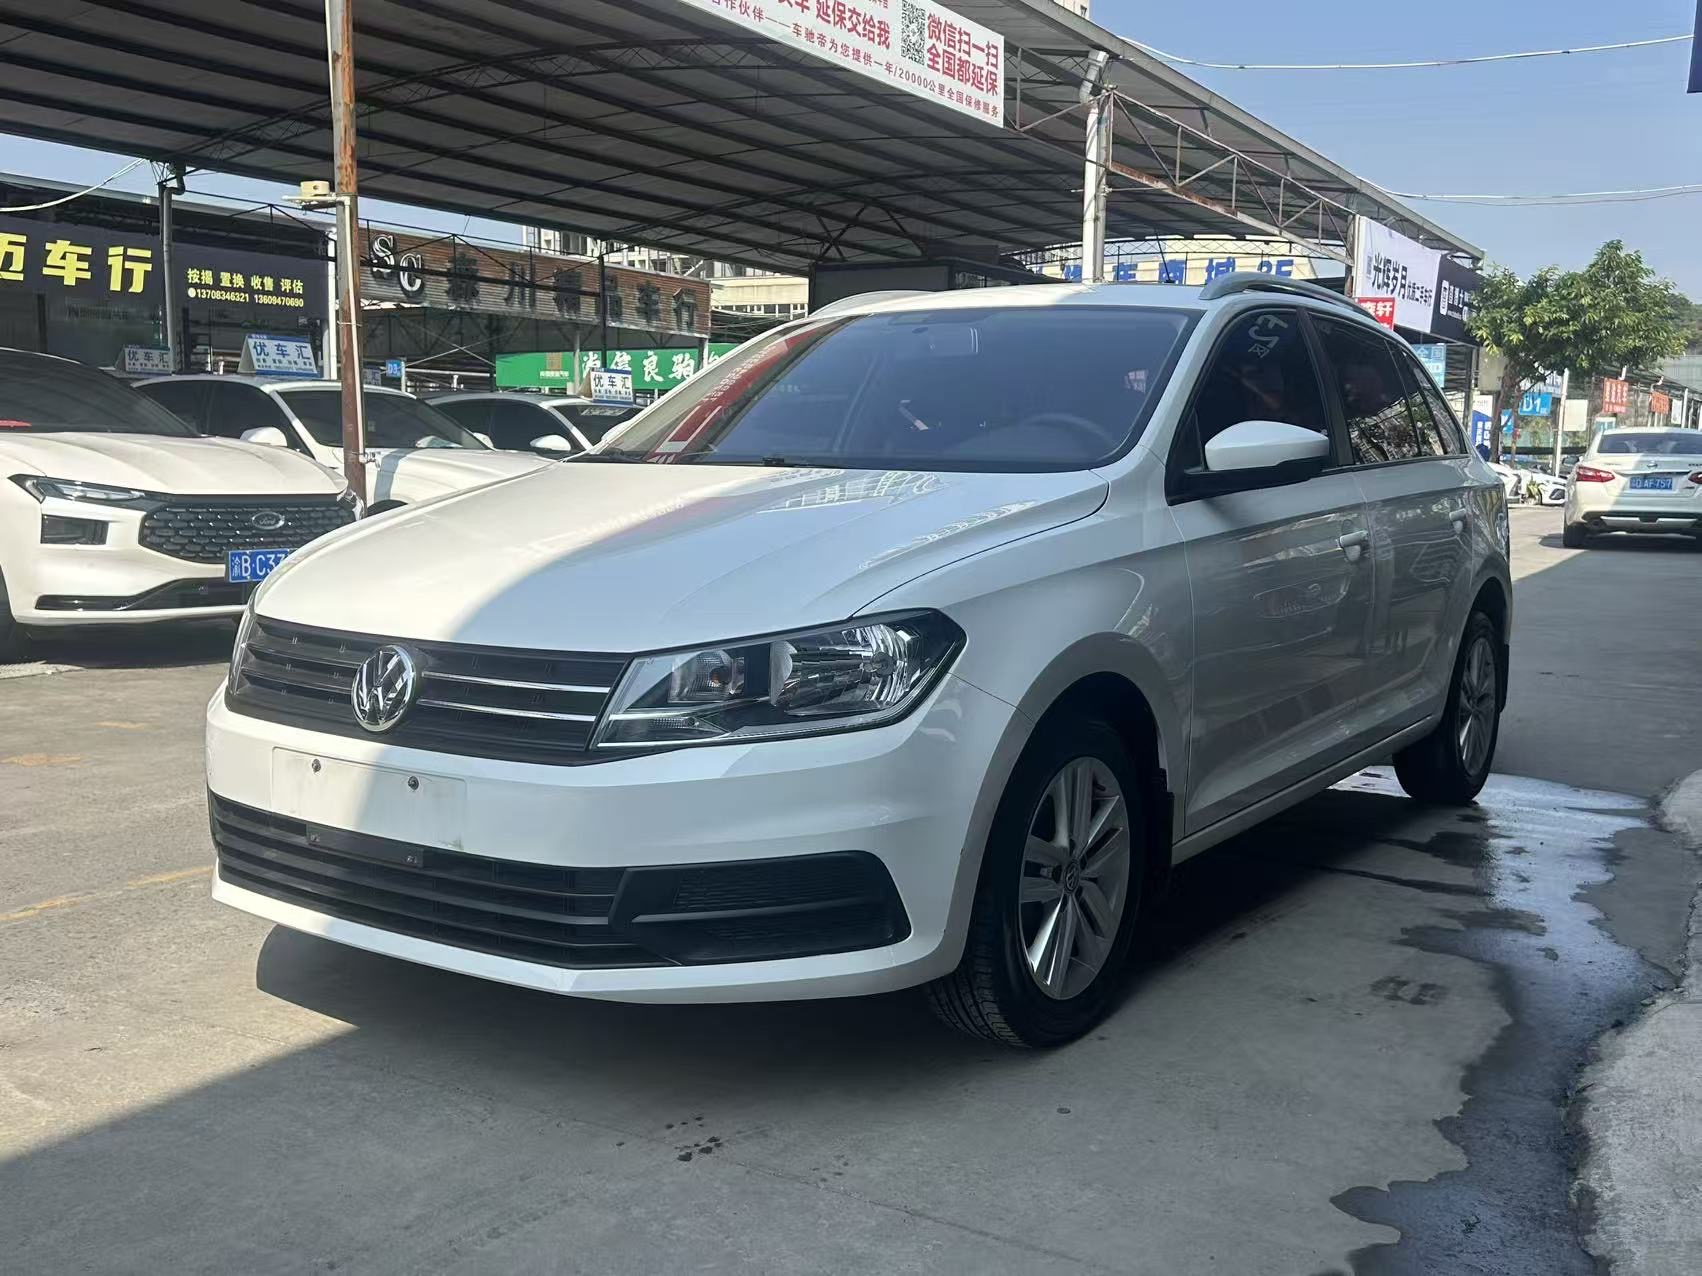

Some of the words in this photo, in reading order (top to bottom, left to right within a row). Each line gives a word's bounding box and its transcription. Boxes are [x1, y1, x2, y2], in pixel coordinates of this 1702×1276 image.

[816, 0, 890, 49] 延保交给我
[927, 13, 999, 70] 微信扫一扫
[926, 43, 998, 97] 全国都延保
[187, 268, 213, 285] 按揭
[220, 271, 245, 288] 置换
[250, 275, 274, 291] 收售
[280, 278, 304, 294] 评估
[128, 349, 169, 363] 优车汇
[253, 341, 311, 360] 优车汇
[594, 374, 631, 389] 优车汇
